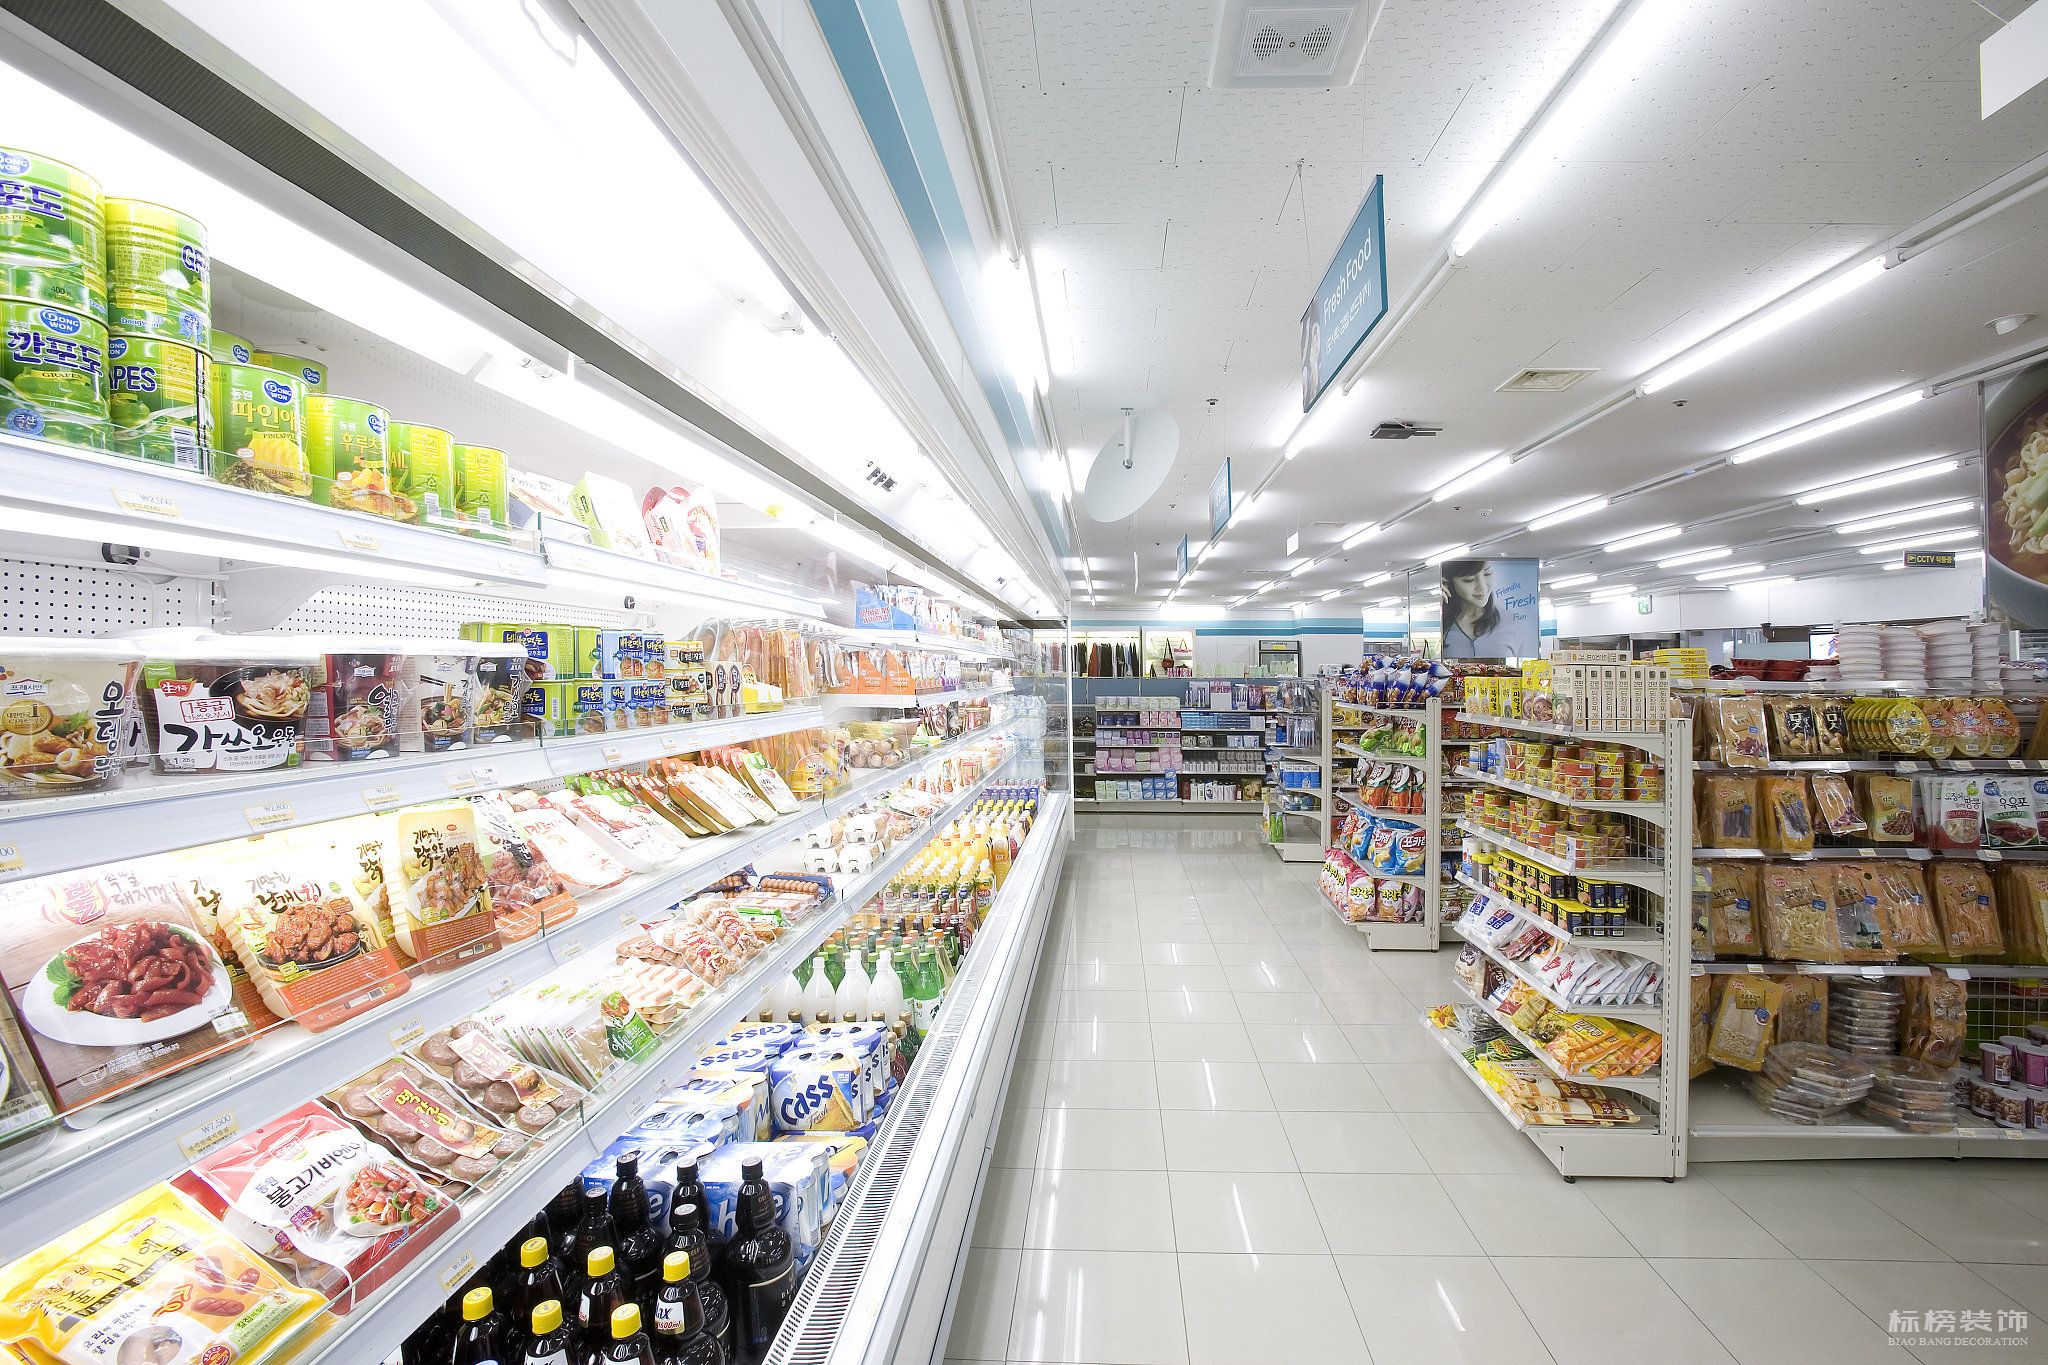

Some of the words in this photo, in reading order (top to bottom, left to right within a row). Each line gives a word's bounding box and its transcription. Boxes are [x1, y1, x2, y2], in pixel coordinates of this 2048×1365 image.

[1324, 275, 1346, 327] Fresh
[1346, 228, 1372, 290] Food
[47, 312, 79, 327] DONG
[49, 321, 73, 332] WON
[7, 330, 103, 377] 깐포도
[265, 382, 292, 396] DONG
[270, 391, 288, 402] WON
[1917, 555, 1935, 563] CCTV
[1504, 594, 1536, 610] Fresh
[1513, 613, 1527, 621] Fun
[163, 723, 276, 755] 가쓰오
[271, 725, 296, 749] 우동
